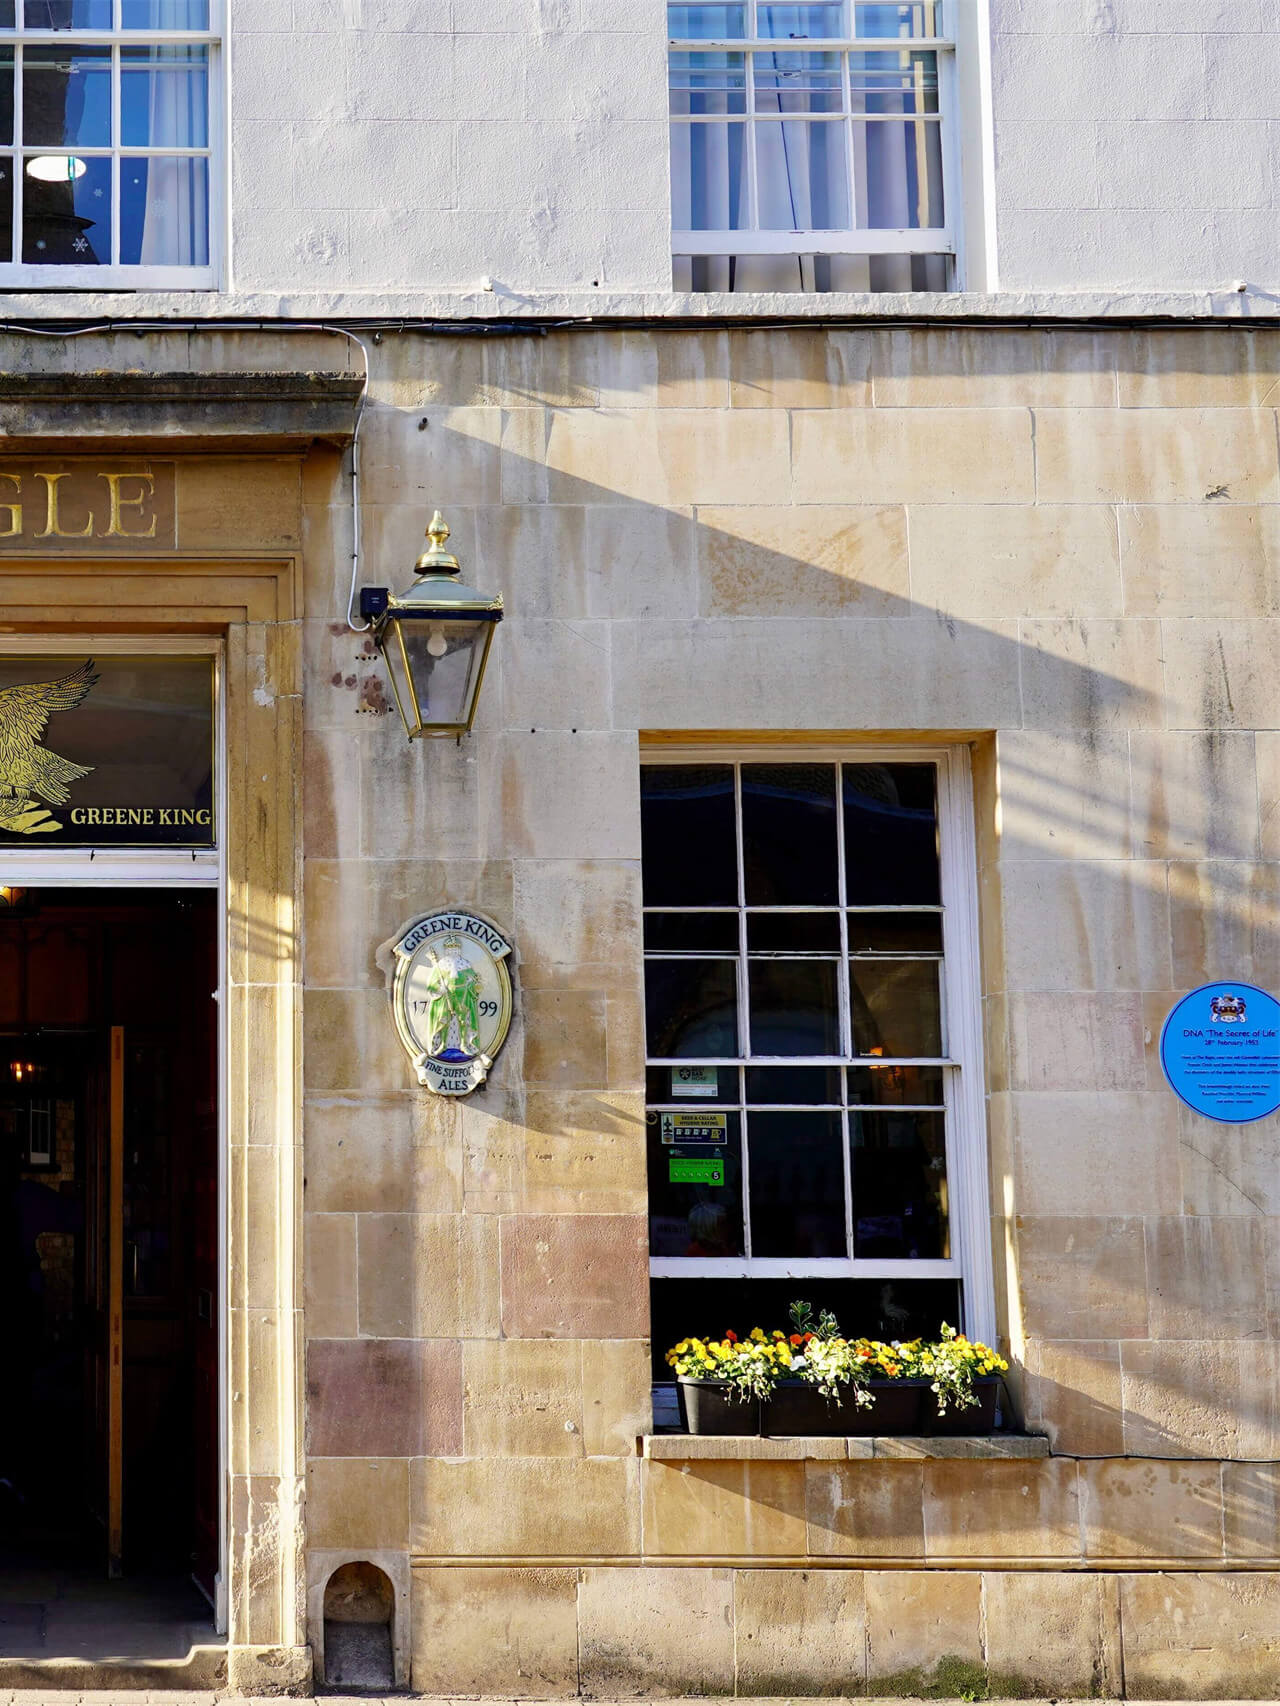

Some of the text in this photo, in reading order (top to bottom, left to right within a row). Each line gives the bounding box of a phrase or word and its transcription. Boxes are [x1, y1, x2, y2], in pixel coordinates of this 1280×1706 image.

[70, 807, 212, 825] GREENE KING
[404, 917, 503, 952] GREENE KING
[413, 1000, 498, 1017] 17 99
[1183, 1029, 1203, 1037] DNA
[1252, 1029, 1260, 1037] of
[424, 1061, 443, 1075] FINE
[438, 1079, 469, 1091] ALES
[713, 1172, 719, 1180] 5
